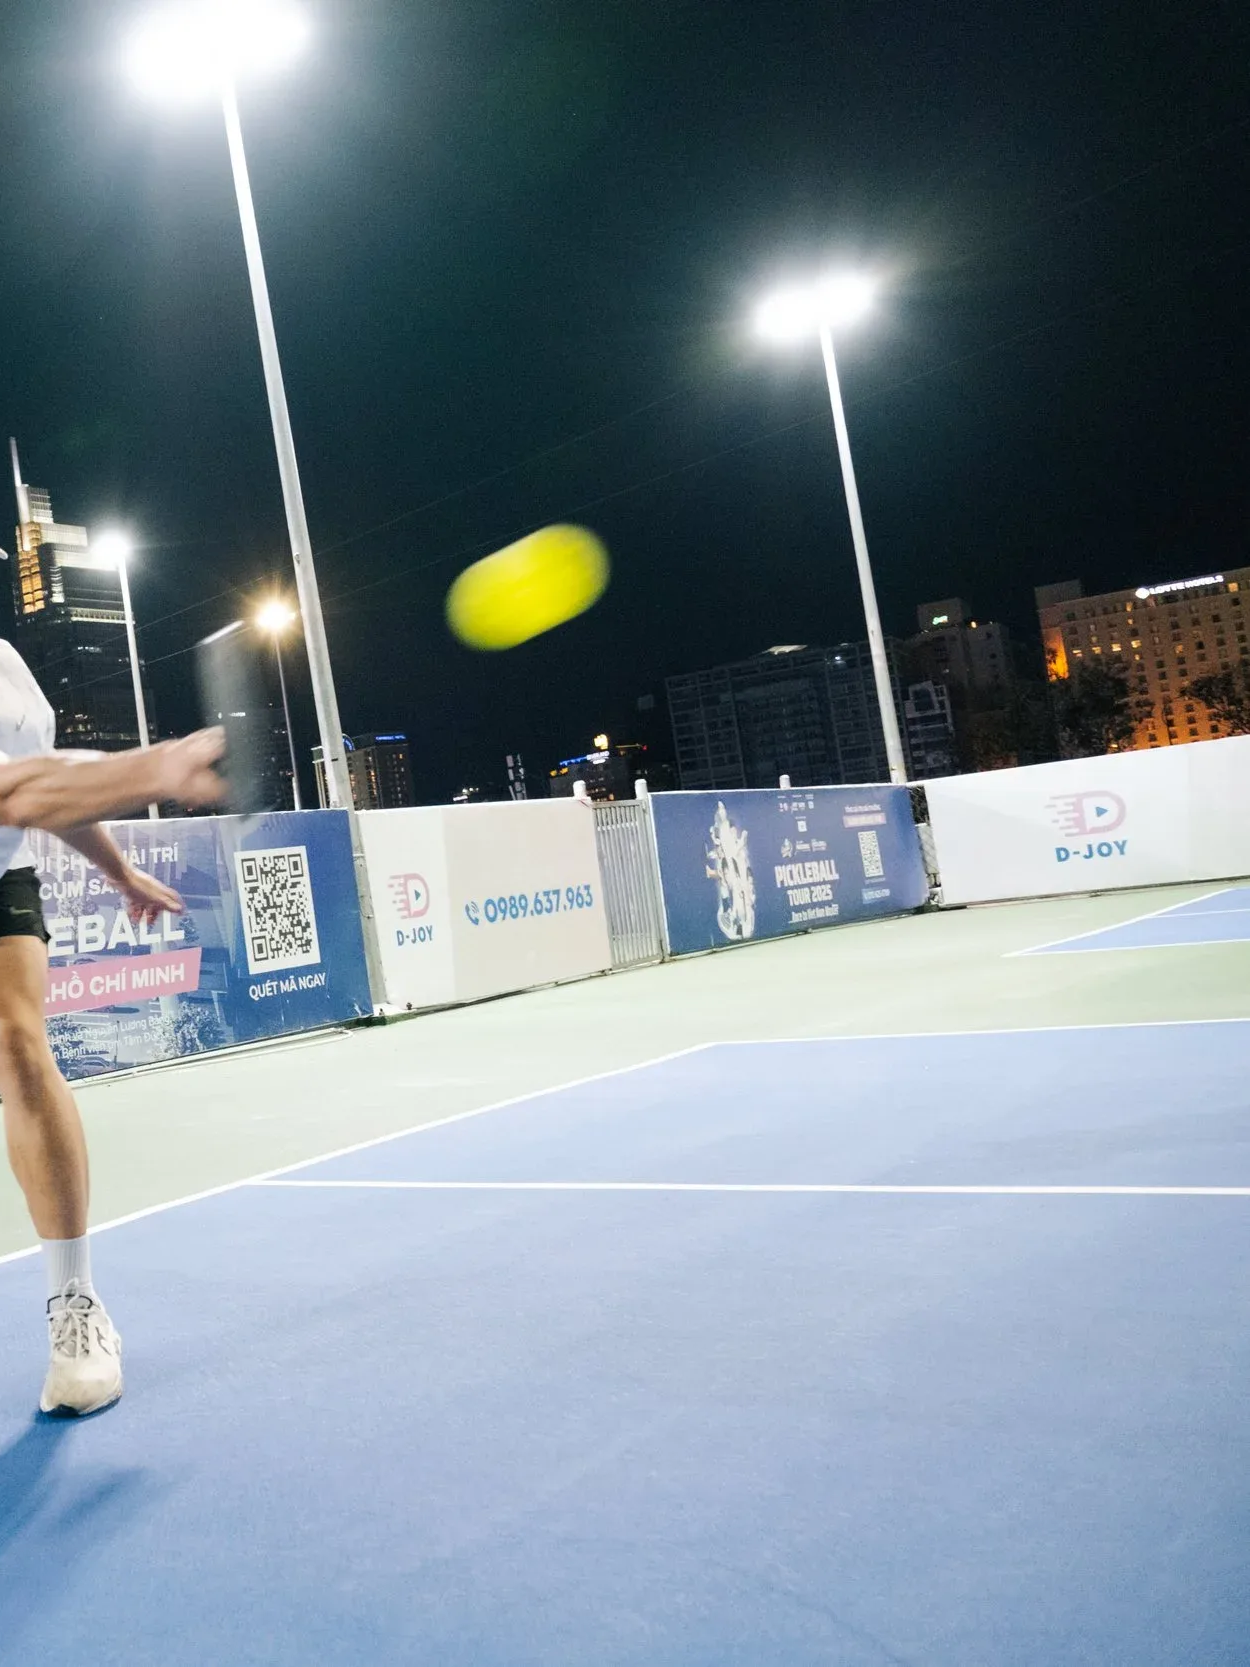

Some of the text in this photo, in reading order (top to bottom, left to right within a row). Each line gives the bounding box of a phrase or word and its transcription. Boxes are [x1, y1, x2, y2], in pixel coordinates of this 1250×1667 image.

[149, 841, 179, 864] TRÍ
[1055, 839, 1128, 862] D-JOY
[774, 859, 840, 888] PICKLEBALL
[483, 884, 594, 924] 0989.637.963
[787, 883, 834, 907] TOUR 2025
[47, 909, 185, 957] EBALL
[396, 925, 434, 947] D-JOY
[44, 963, 185, 1003] .HỒ CHÍ MINH
[249, 972, 327, 1001] QUÉT MÃ NGAY
